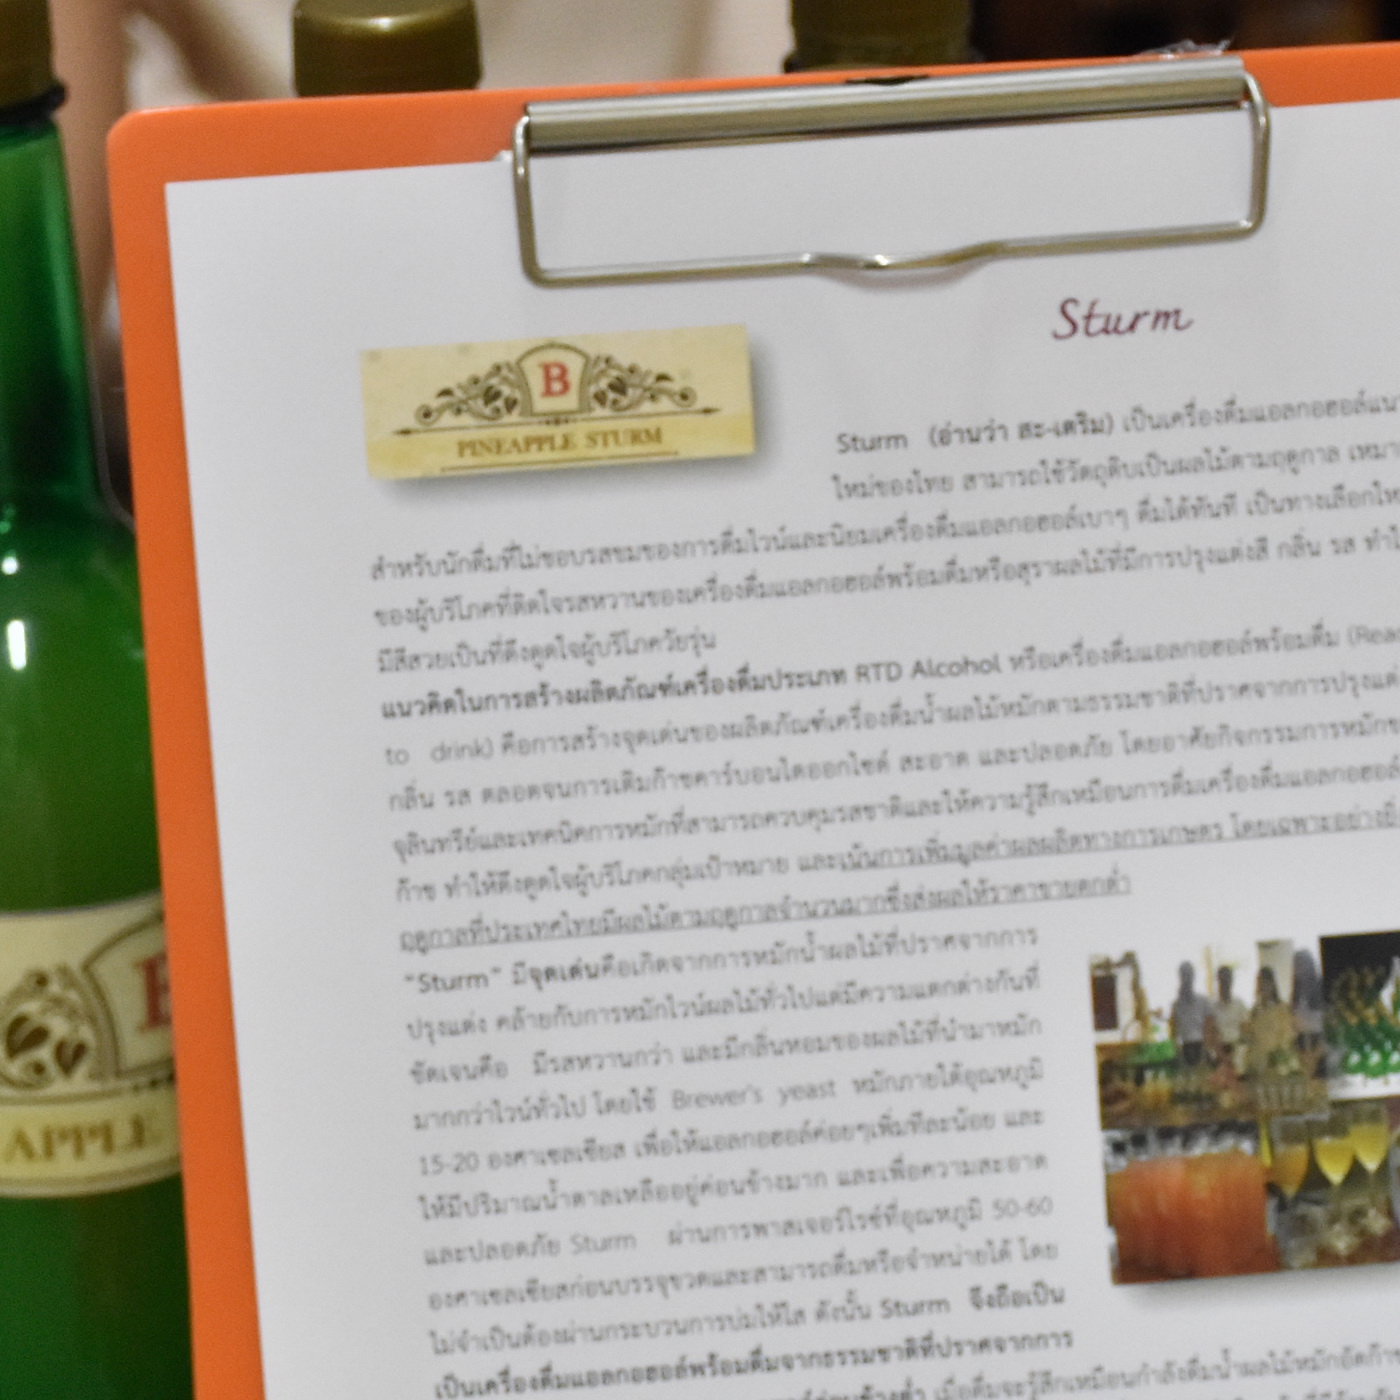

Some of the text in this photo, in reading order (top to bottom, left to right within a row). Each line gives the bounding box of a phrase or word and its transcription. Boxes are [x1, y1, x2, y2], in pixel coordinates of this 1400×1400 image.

[1052, 297, 1193, 341] Sturm
[538, 361, 572, 398] B
[457, 426, 663, 459] PINEAPPLE STURM
[836, 432, 909, 455] Sturm
[928, 418, 1009, 448] (อ่านว่า
[1277, 533, 1321, 559] กลิ่น
[1330, 537, 1356, 555] รส
[854, 661, 903, 683] RTD
[910, 653, 1002, 679] Alcohol
[385, 748, 409, 765] to
[430, 738, 494, 762] drink)
[389, 785, 435, 811] กลิ่น
[444, 788, 471, 807] รส
[899, 751, 969, 773] สะอาด
[406, 1017, 487, 1046] ปรุงแต่ง
[592, 1086, 656, 1116] โดยใช้
[779, 1080, 835, 1109] yeast
[420, 1152, 480, 1176] 15-20
[1004, 1110, 1043, 1128] และ
[570, 1234, 636, 1254] Sturm
[992, 1196, 1053, 1219] 50-60
[1018, 1236, 1058, 1262] โดย
[814, 1289, 872, 1323] ดังนั้น
[880, 1298, 951, 1319] Sturm
